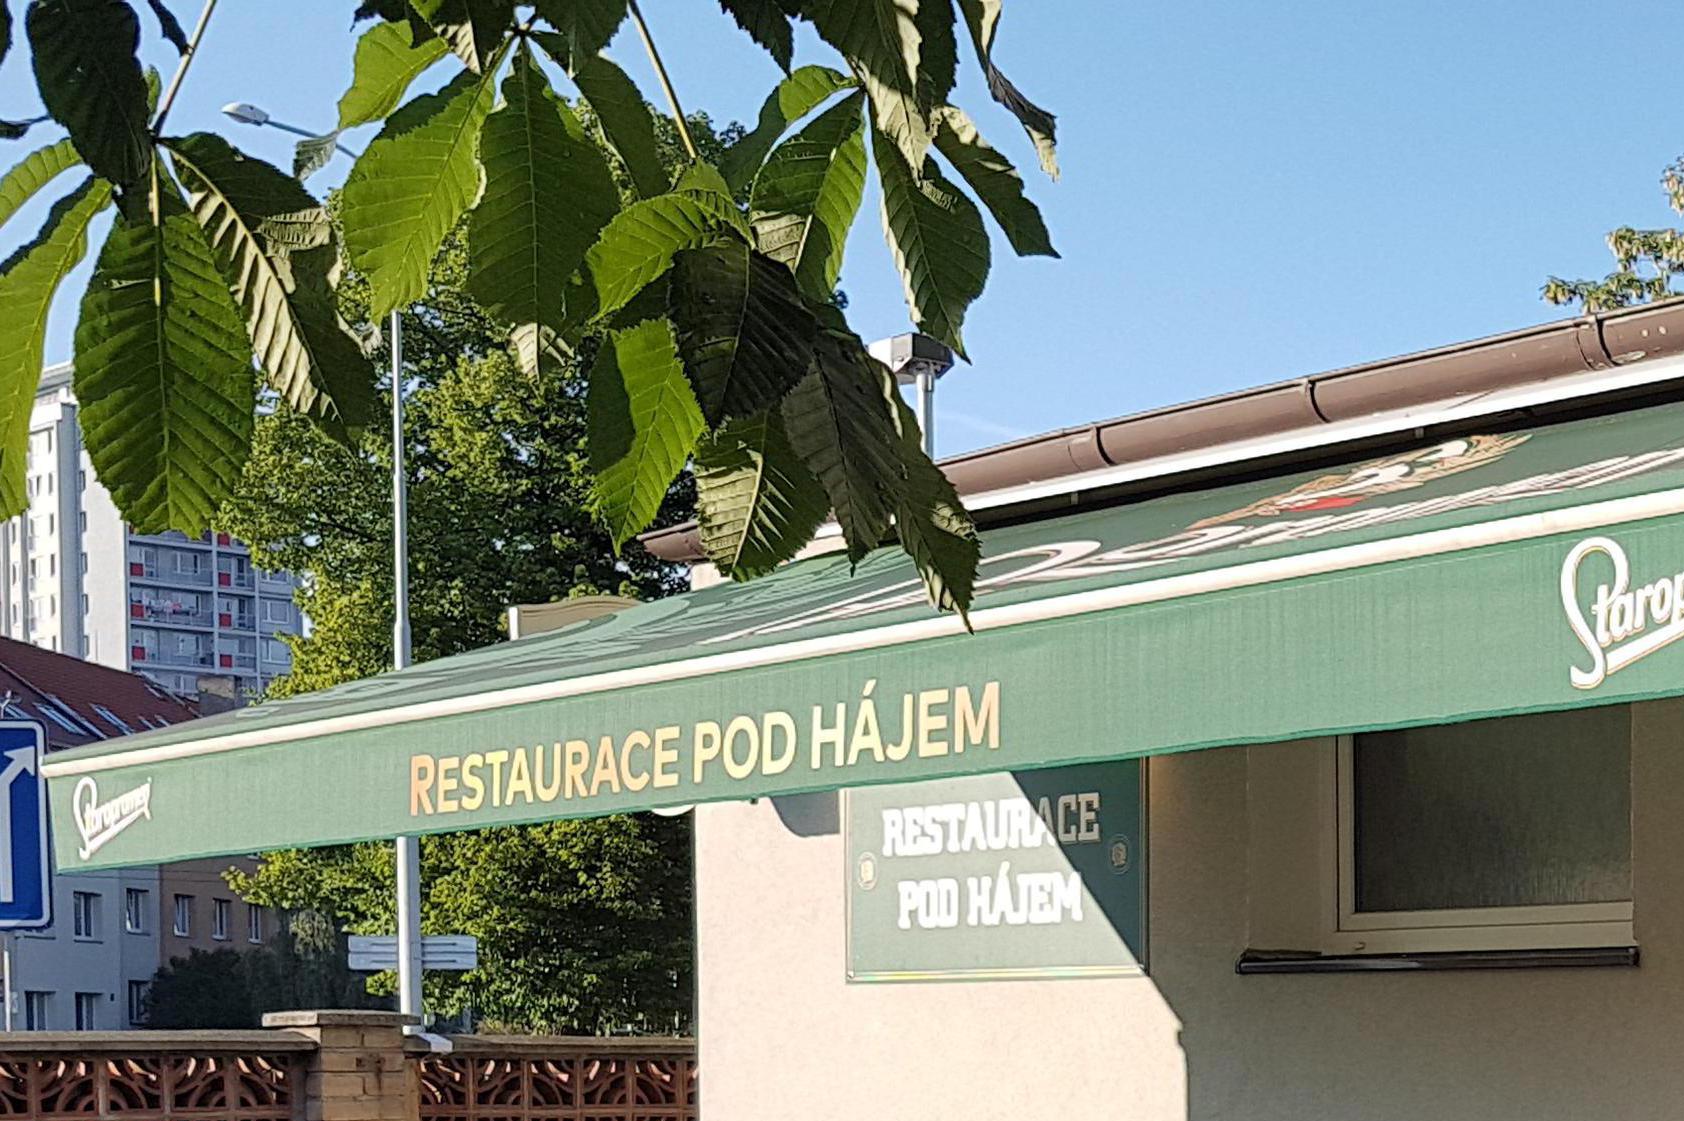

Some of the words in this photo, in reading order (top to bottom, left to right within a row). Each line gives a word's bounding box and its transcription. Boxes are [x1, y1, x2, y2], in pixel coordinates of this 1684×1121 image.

[410, 725, 680, 816] RESTAURACE
[693, 710, 797, 784] POD
[810, 679, 1000, 770] HÁJEM
[881, 792, 1101, 857] RESTAURACE
[897, 877, 959, 929] POD
[967, 860, 1083, 927] HÁJEM
